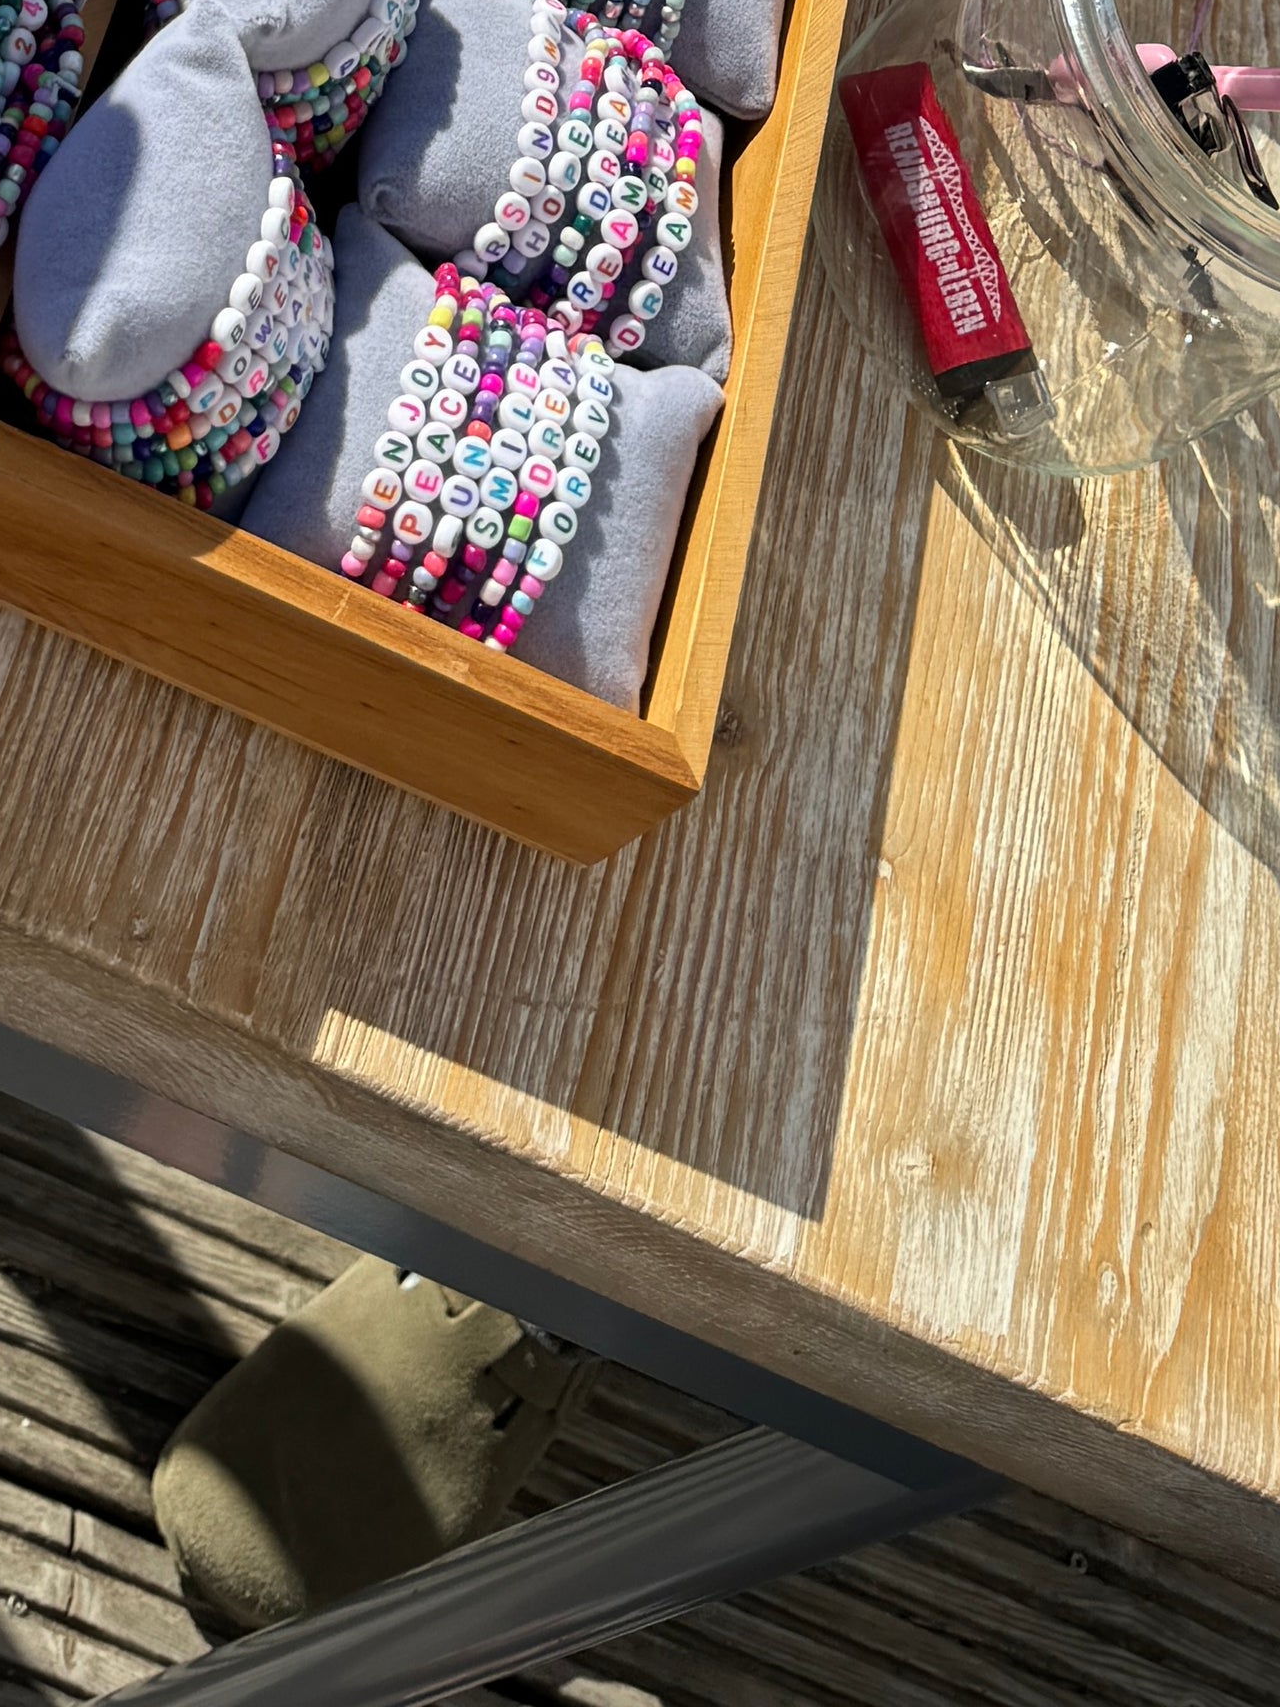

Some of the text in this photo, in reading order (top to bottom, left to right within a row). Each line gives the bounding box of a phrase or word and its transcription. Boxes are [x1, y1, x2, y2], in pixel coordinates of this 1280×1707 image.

[525, 129, 590, 253] HOPE
[617, 187, 696, 347] DREAM
[373, 331, 446, 500] ENJOY
[399, 360, 477, 536] PEACE
[474, 368, 537, 538] SMILE
[527, 352, 610, 567] FOREVER
